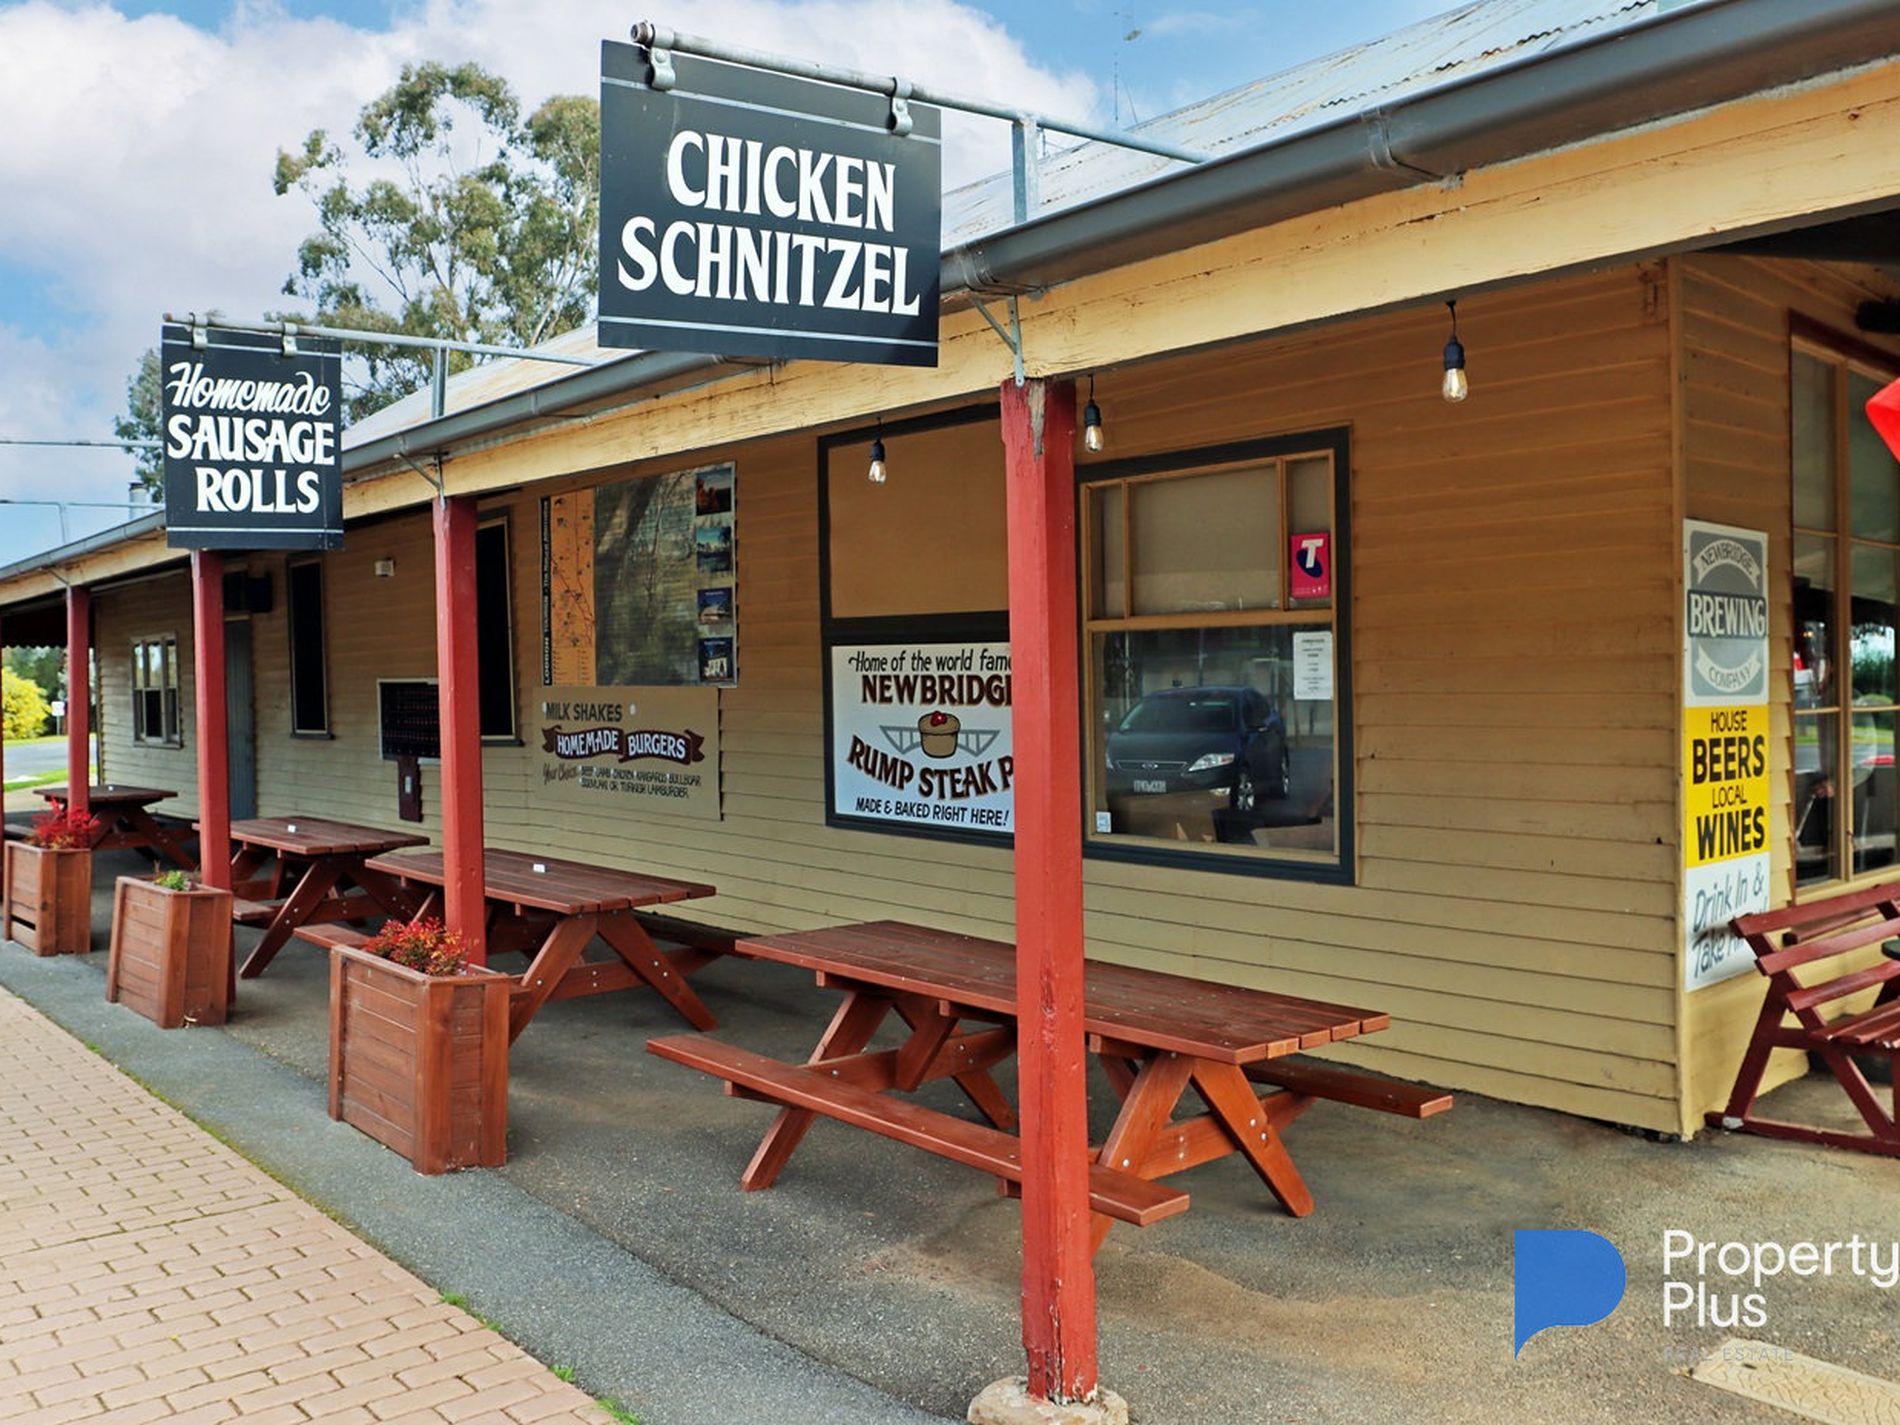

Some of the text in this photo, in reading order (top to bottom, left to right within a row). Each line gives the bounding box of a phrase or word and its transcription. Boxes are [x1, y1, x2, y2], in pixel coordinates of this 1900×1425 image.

[667, 130, 896, 232] CHICKEN
[617, 215, 920, 316] SCHNITZEL
[165, 362, 331, 416] Homemade
[167, 414, 335, 466] SAUSAGE
[195, 467, 320, 514] ROLLS
[1301, 538, 1324, 569] T
[1701, 541, 1755, 575] NEWBRIDGE
[1690, 593, 1766, 638] BREWING
[848, 651, 888, 672] Home
[891, 650, 907, 672] of
[911, 649, 932, 672] the
[936, 649, 974, 671] world
[1708, 665, 1750, 689] COMPANY
[546, 702, 623, 722] MILK SHAKES
[1711, 710, 1747, 733] HOUSE
[557, 730, 686, 759] HOMEMADE BURGERS
[847, 735, 914, 791] RUMP
[918, 761, 998, 800] STEAK
[1692, 734, 1765, 784] BEERS
[855, 797, 1009, 826] MADE & BAKED RIGHT HERE!
[1712, 785, 1748, 809] LOCAL
[1696, 806, 1765, 860] WINES
[1693, 861, 1765, 932] Drink In &
[1692, 929, 1726, 978] Take
